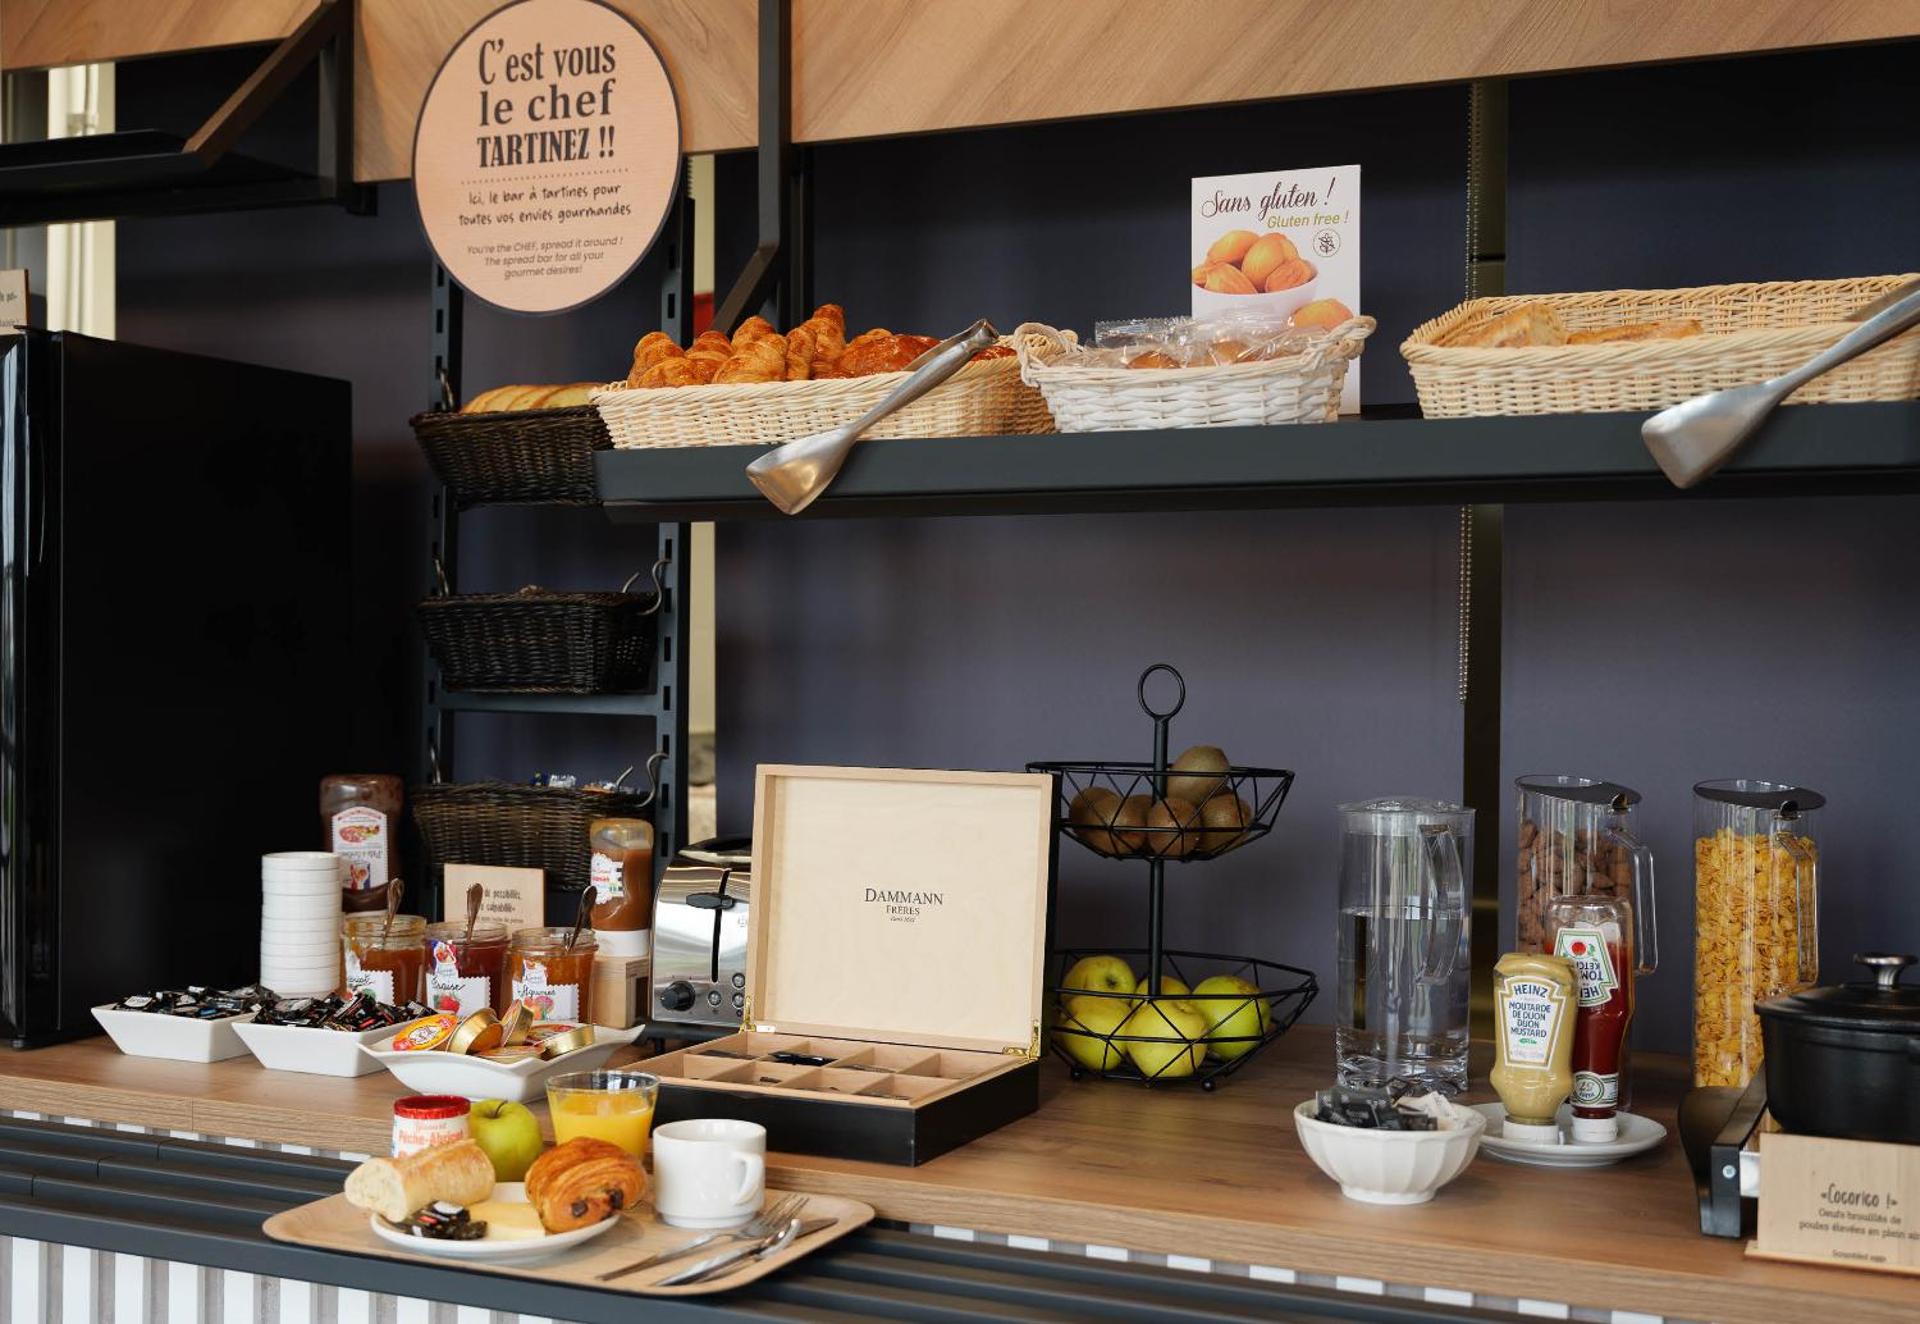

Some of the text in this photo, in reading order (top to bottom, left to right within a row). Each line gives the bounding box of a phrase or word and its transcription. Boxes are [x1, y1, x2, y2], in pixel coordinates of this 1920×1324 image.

[478, 38, 616, 85] C'est vous
[479, 78, 616, 126] le chef
[477, 125, 615, 168] TARTINEZ !!
[489, 191, 498, 204] le
[503, 190, 524, 203] bar
[529, 185, 537, 200] à
[542, 185, 588, 199] tartines
[592, 184, 622, 200] pour
[1201, 176, 1336, 221] Sans gluten !
[459, 202, 631, 226] toutes vos envies gourmandes
[1267, 210, 1350, 228] Gluten free !
[497, 243, 512, 252] the
[540, 239, 574, 251] spread
[576, 238, 582, 247] it
[583, 237, 618, 247] around
[485, 257, 501, 266] The
[502, 254, 536, 267] spread
[536, 254, 553, 263] bar
[554, 253, 568, 262] for
[569, 252, 581, 261] all
[503, 265, 583, 281] gourmet desires!
[864, 888, 944, 905] DAMMANN
[1514, 984, 1548, 998] HEINZ
[1579, 986, 1600, 998] HEI
[1509, 1001, 1551, 1013] MOUTARDE
[1512, 1010, 1546, 1021] DE DIJON
[1517, 1018, 1540, 1028] DIJON
[1511, 1026, 1547, 1038] MUSTARD
